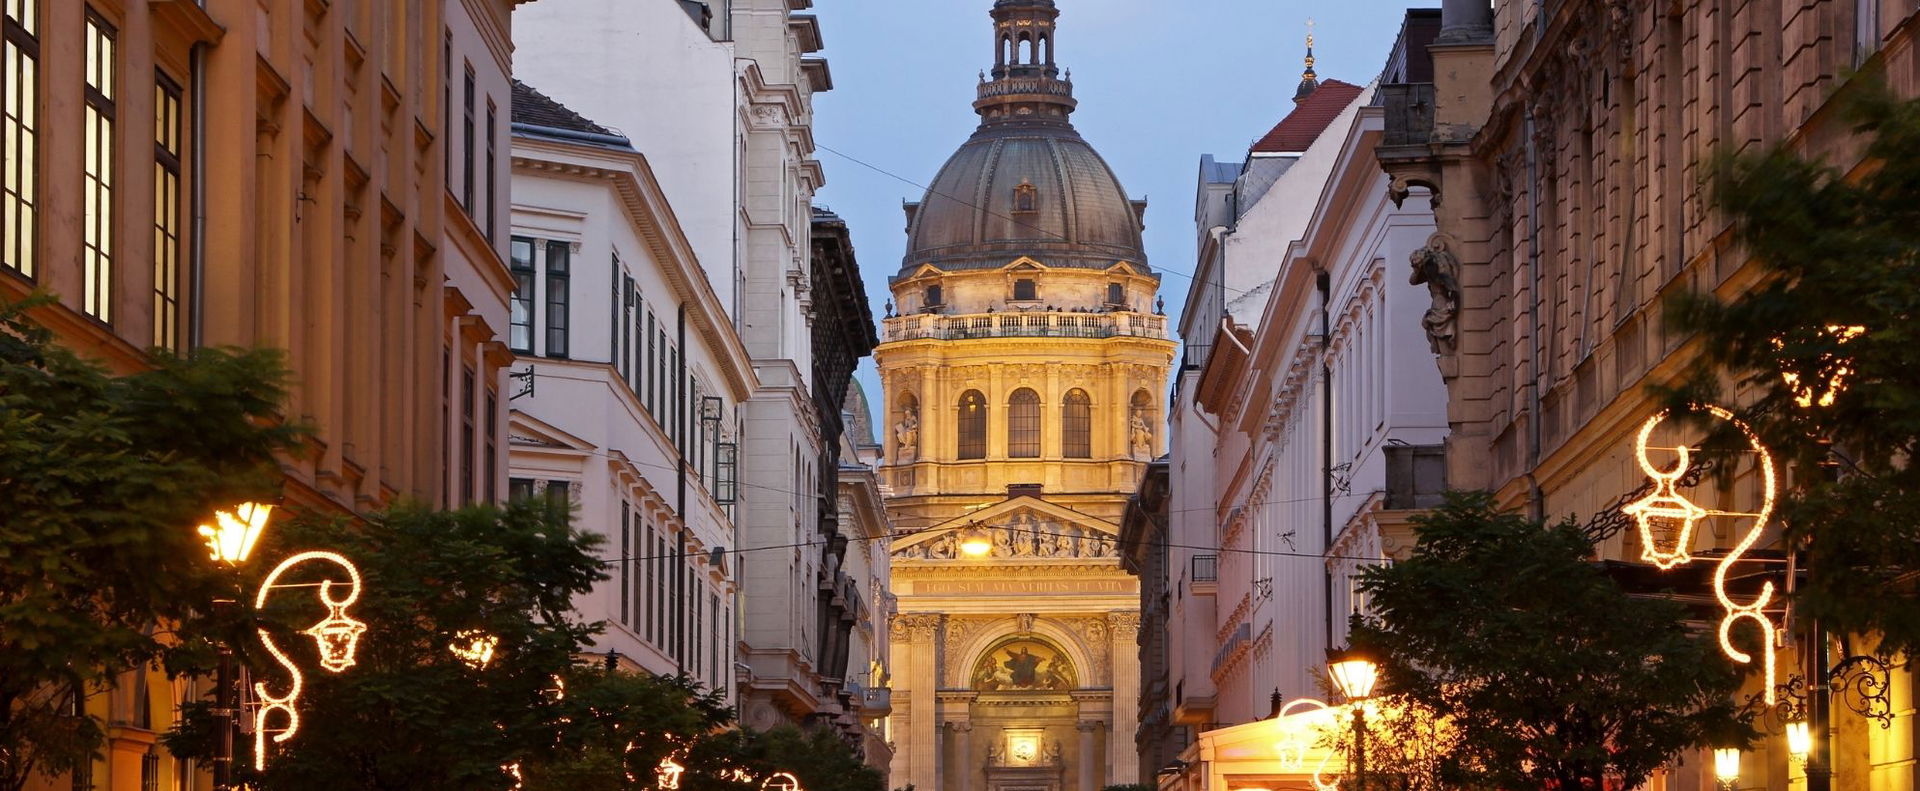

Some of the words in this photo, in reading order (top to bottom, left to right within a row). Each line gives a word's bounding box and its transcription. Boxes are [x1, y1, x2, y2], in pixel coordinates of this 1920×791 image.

[926, 583, 950, 593] EGO
[958, 583, 984, 593] SUM
[1097, 581, 1123, 592] VITA
